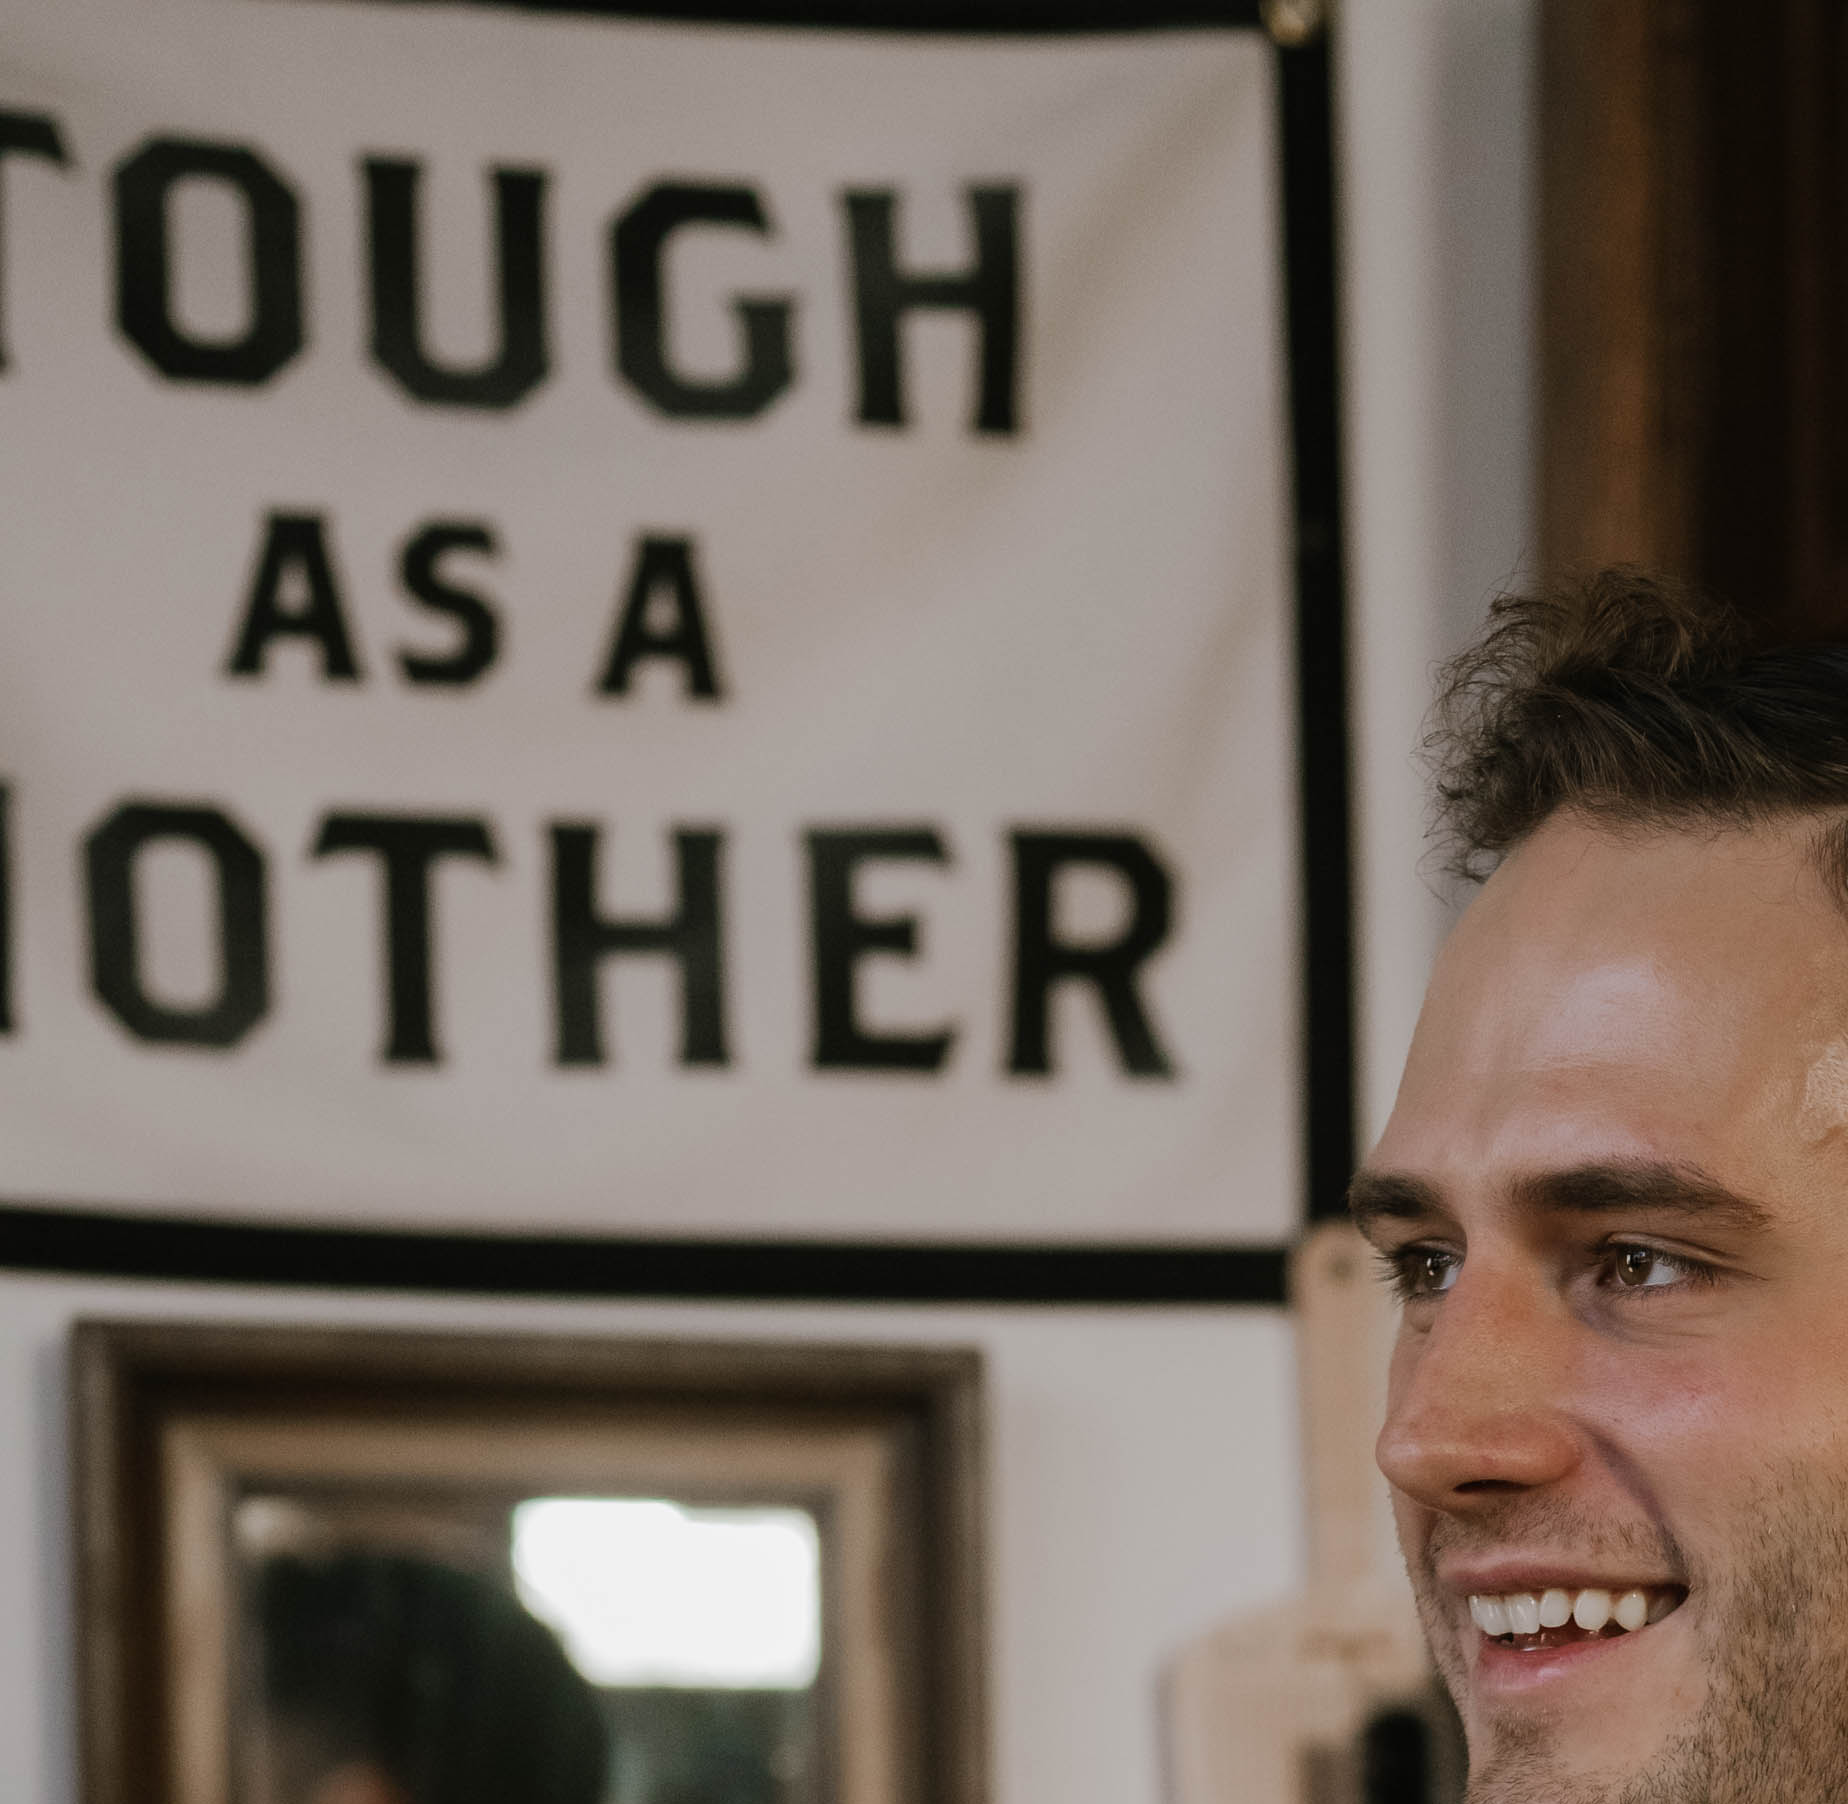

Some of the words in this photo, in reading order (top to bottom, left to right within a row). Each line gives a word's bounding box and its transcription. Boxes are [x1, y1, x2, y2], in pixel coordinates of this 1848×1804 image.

[224, 506, 506, 692] AS
[592, 530, 727, 706] A
[0, 782, 1181, 1084] OTHER
